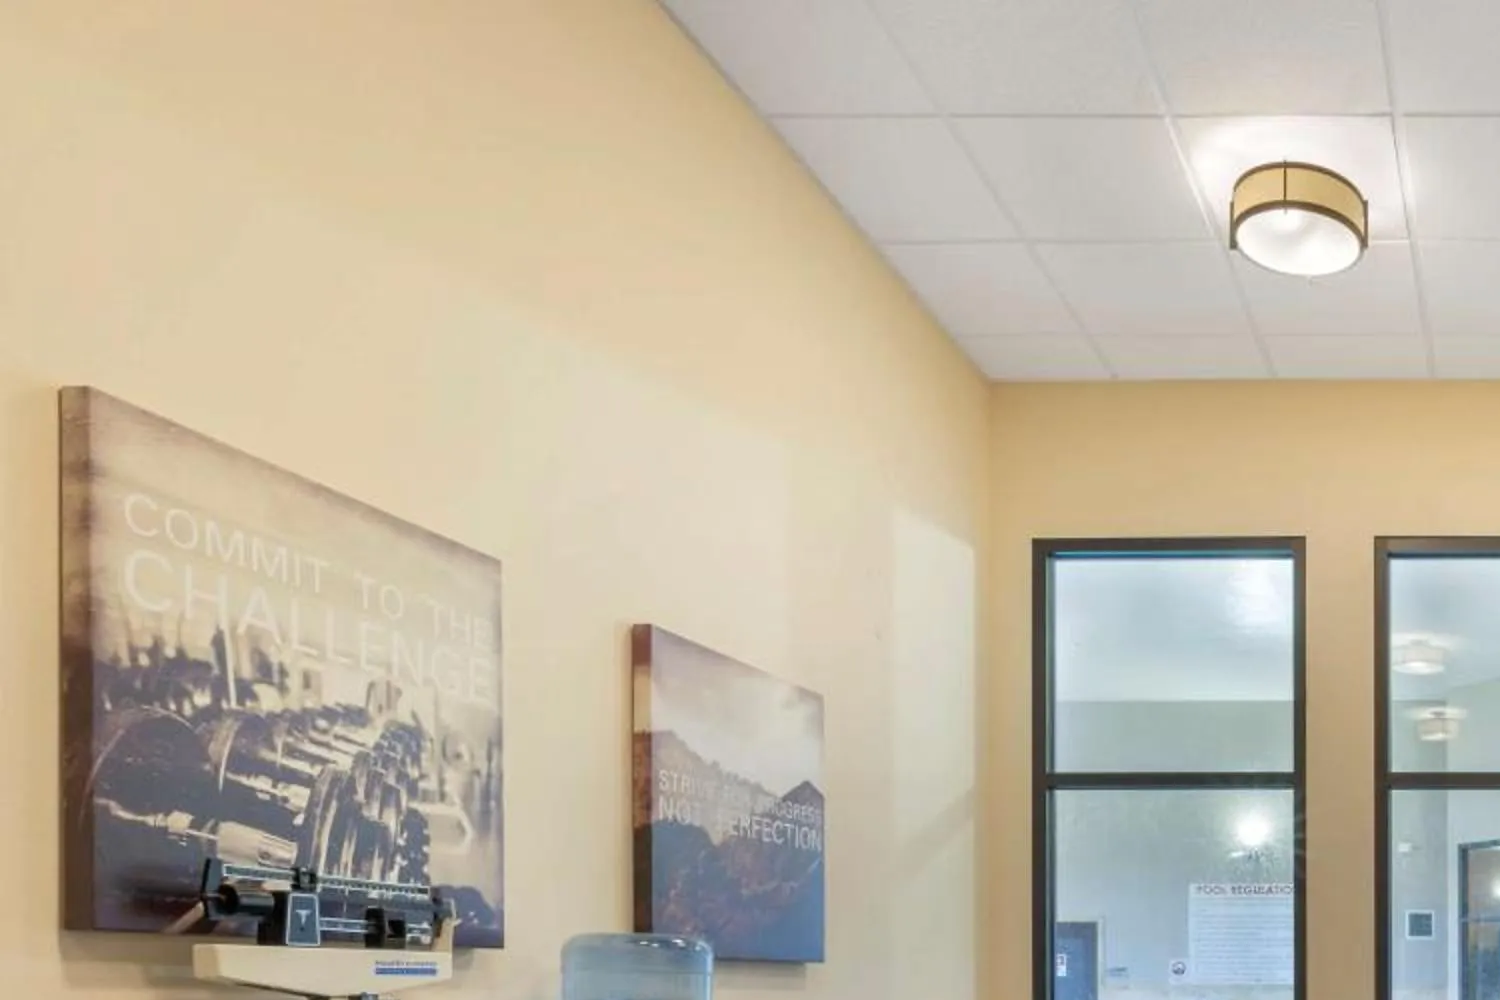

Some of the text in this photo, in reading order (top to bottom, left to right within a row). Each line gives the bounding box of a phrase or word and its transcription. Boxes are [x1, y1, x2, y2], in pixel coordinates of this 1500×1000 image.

[124, 493, 491, 650] COMMIT TO THE
[124, 549, 497, 697] CHALLENGE
[659, 769, 717, 799] STRIVE
[659, 796, 822, 851] NOT PERFECTION
